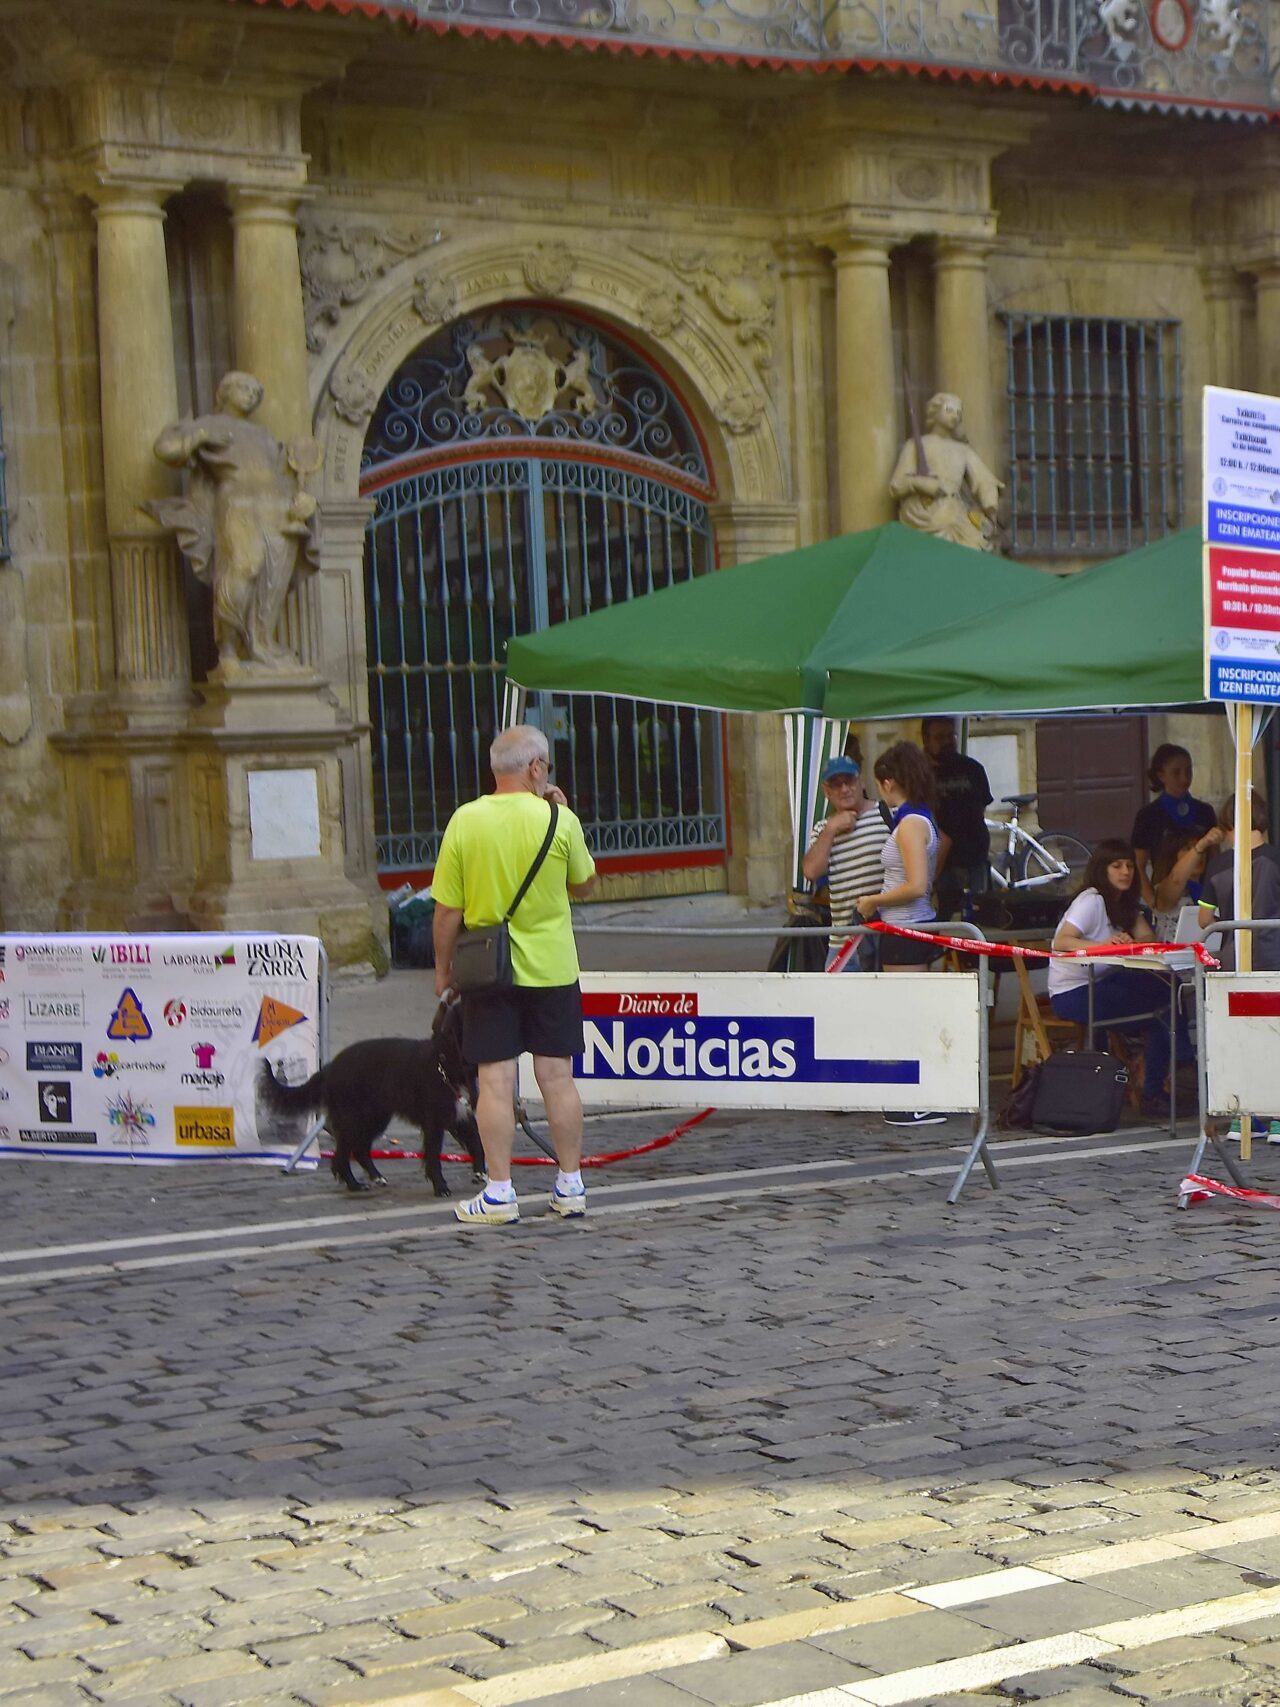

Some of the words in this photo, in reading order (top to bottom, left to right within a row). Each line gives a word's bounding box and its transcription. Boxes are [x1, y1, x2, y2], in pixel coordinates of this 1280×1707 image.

[1218, 523, 1241, 536] IZEN
[1219, 681, 1244, 693] IZEN
[110, 943, 152, 965] IBILI
[163, 954, 213, 967] LABORAL
[246, 938, 304, 963] IRUÑA
[247, 960, 308, 981] ZARRA
[618, 993, 670, 1014] Diario
[673, 994, 693, 1014] de
[582, 1020, 797, 1078] Noticias
[179, 1120, 231, 1141] urbasa
